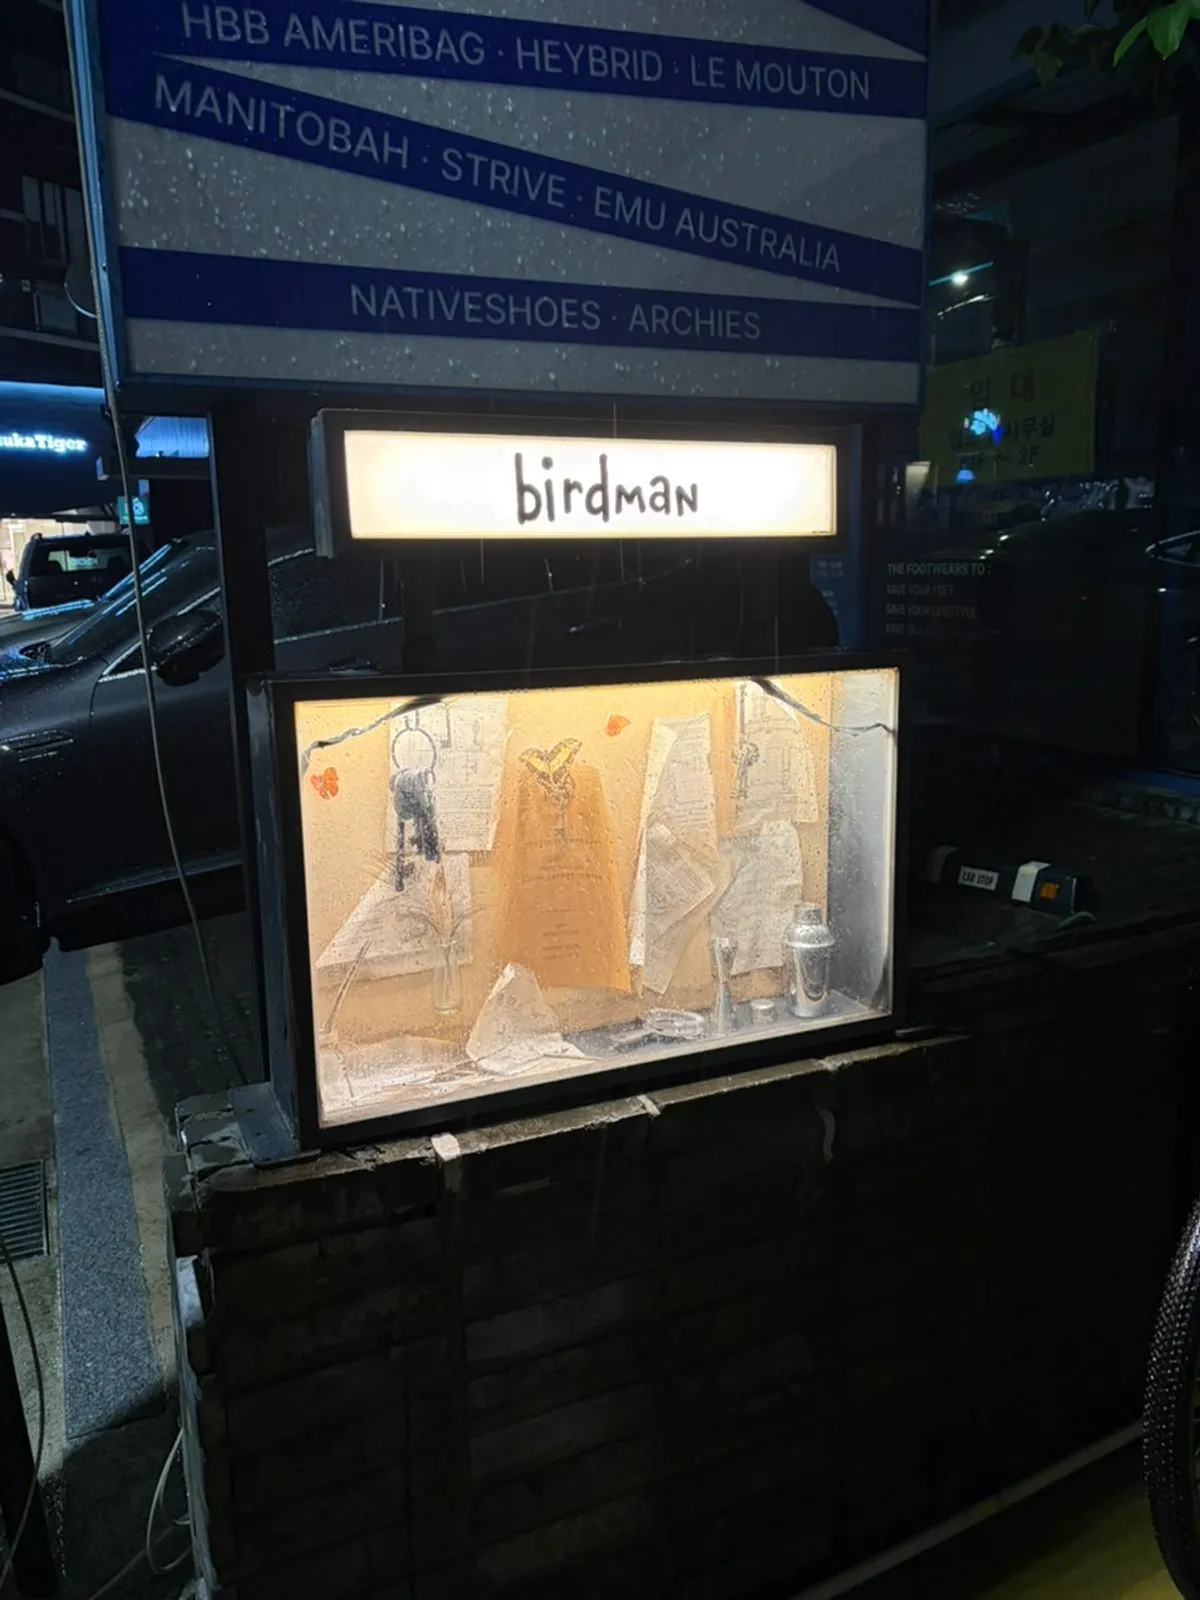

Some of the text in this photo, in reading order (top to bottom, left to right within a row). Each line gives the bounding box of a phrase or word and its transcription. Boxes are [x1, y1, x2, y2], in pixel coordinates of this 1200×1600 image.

[181, 1, 870, 100] HBB AMERIBAG HEYBRID LE MOUTON
[154, 73, 841, 273] MANITOBAH STRIVE EMU AUSTRALIA
[351, 283, 761, 340] NATIVESHOES ARCHIES
[514, 452, 698, 525] birdman
[887, 562, 905, 575] THE
[906, 563, 969, 576] FOOTWEARS
